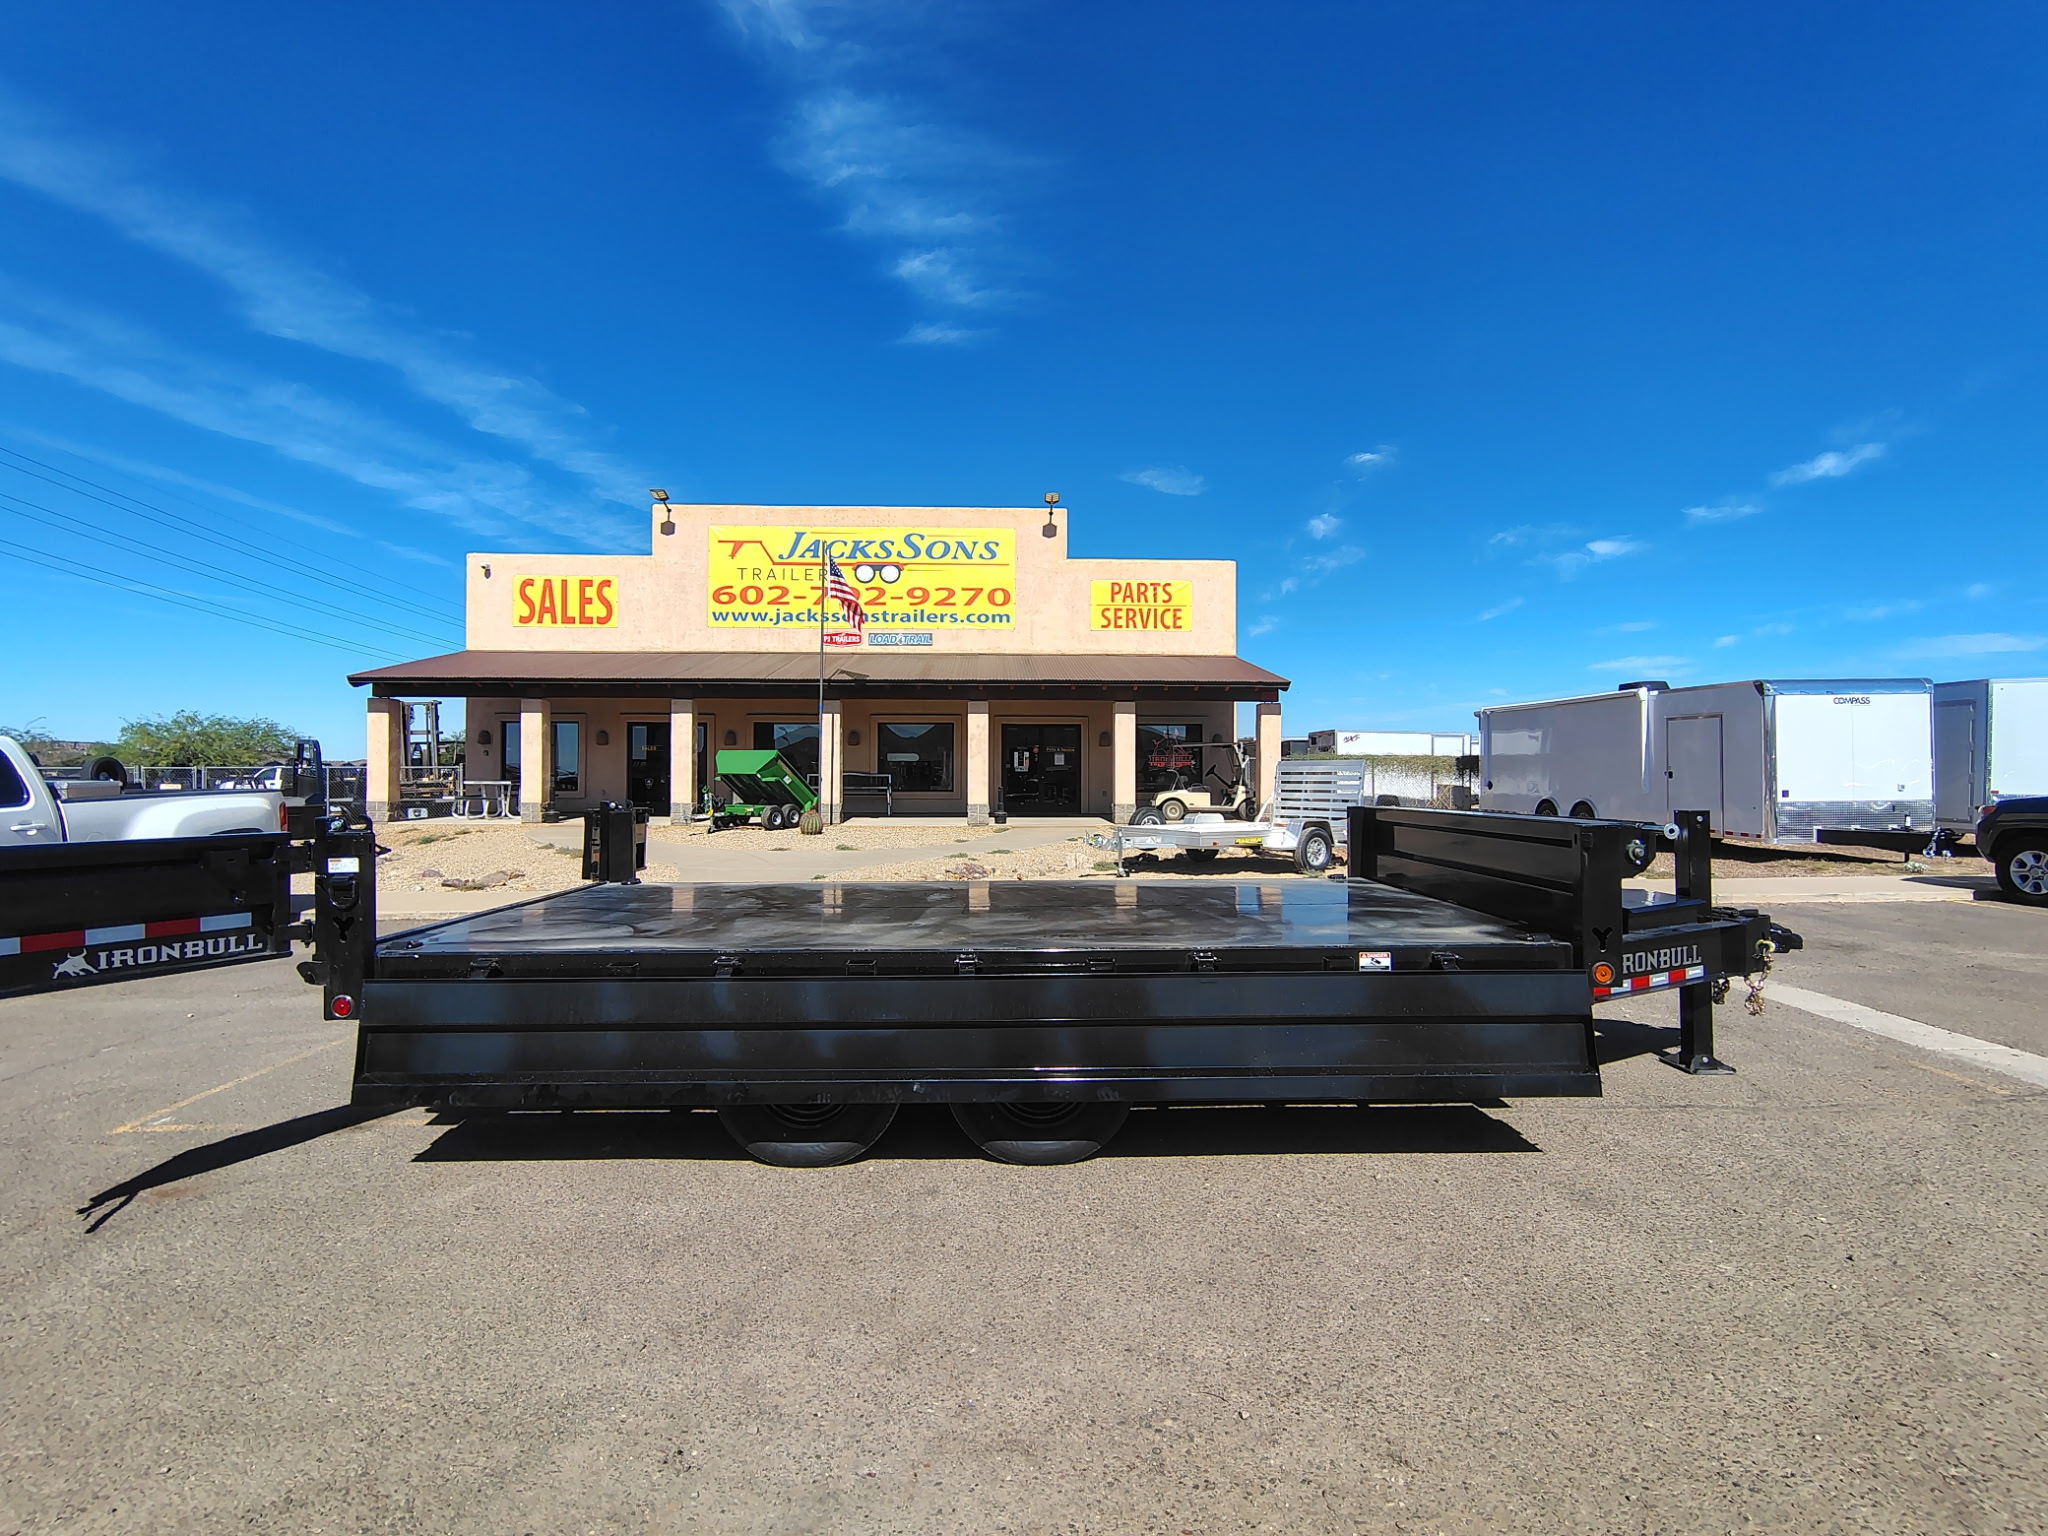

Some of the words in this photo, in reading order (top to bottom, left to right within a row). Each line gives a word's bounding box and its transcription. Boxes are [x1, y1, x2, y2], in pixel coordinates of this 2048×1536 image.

[519, 578, 613, 625] SALES
[1110, 582, 1172, 603] PARTS
[1101, 607, 1182, 629] SERVICE
[832, 635, 860, 643] TRAILERS
[869, 634, 897, 645] LOAD
[901, 634, 932, 645] TRAIL
[1833, 696, 1871, 705] COMPASS
[98, 933, 263, 970] IRONBULL
